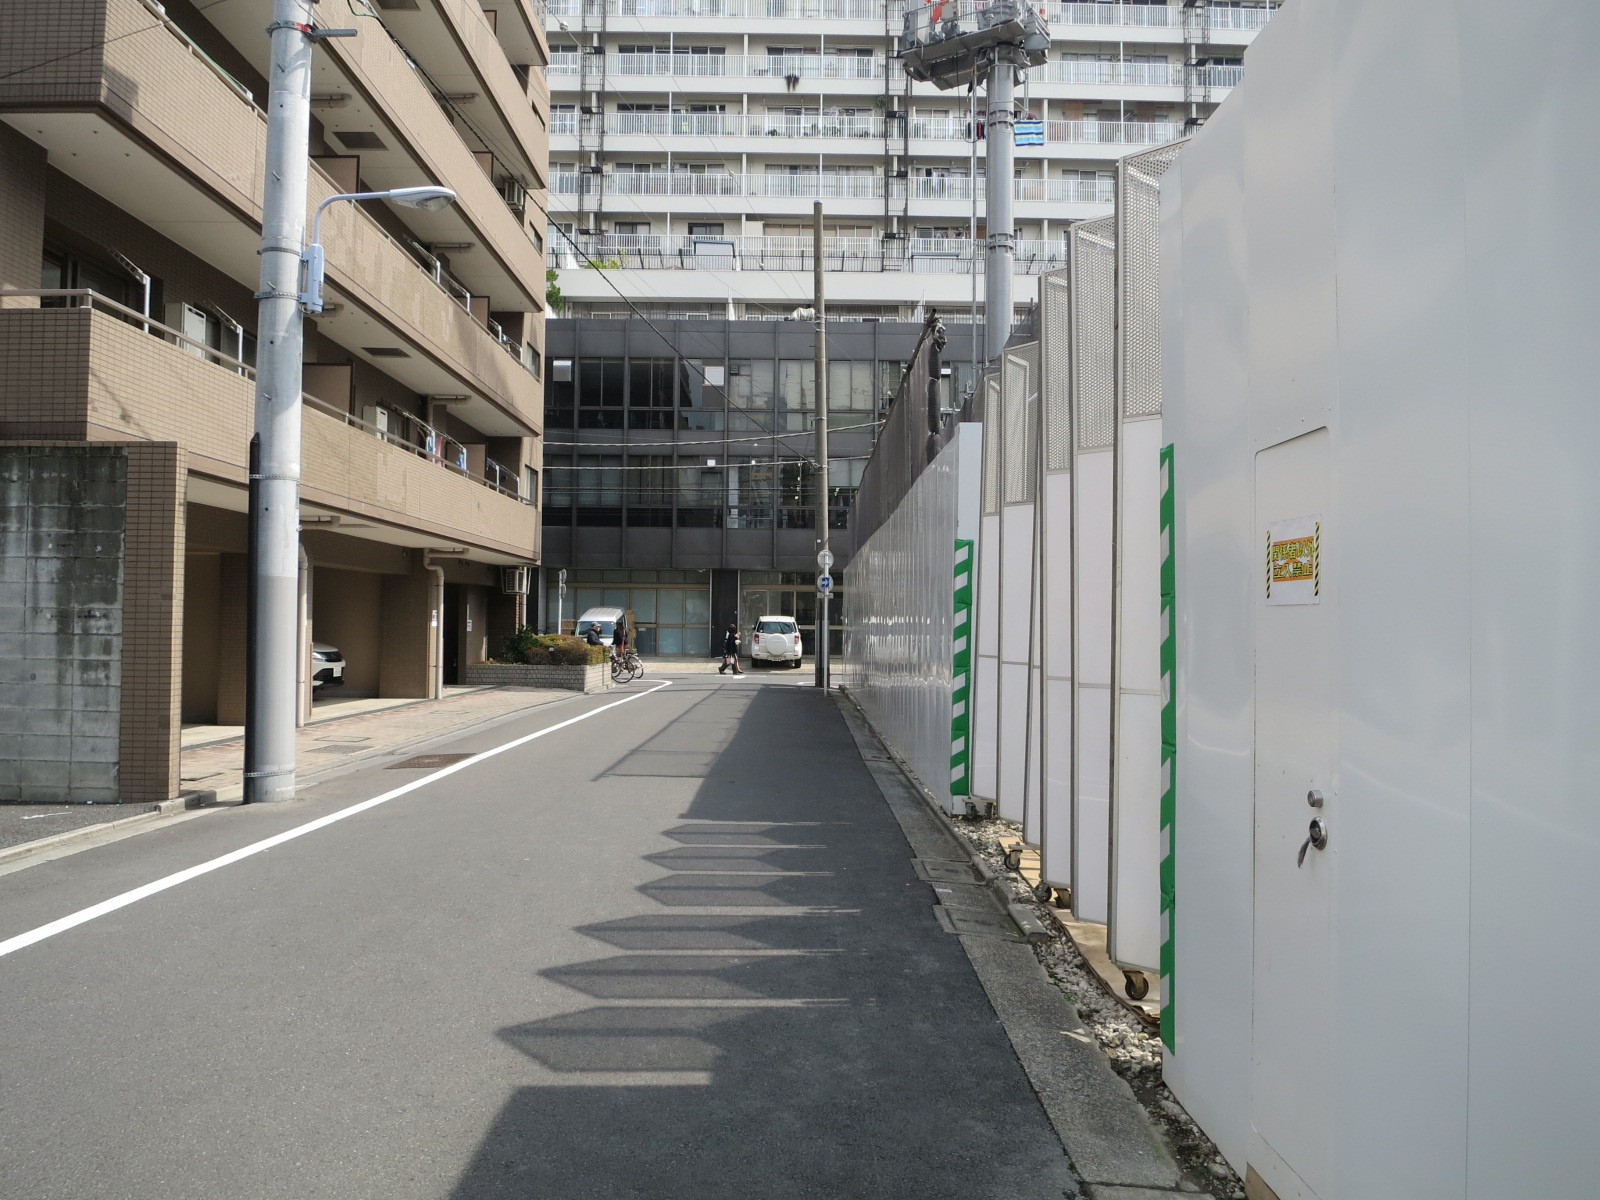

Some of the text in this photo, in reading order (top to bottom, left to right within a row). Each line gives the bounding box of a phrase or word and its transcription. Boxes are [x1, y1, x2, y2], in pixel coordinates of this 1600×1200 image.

[1271, 538, 1315, 562] 関係者以外
[1273, 560, 1313, 578] 立入禁止
